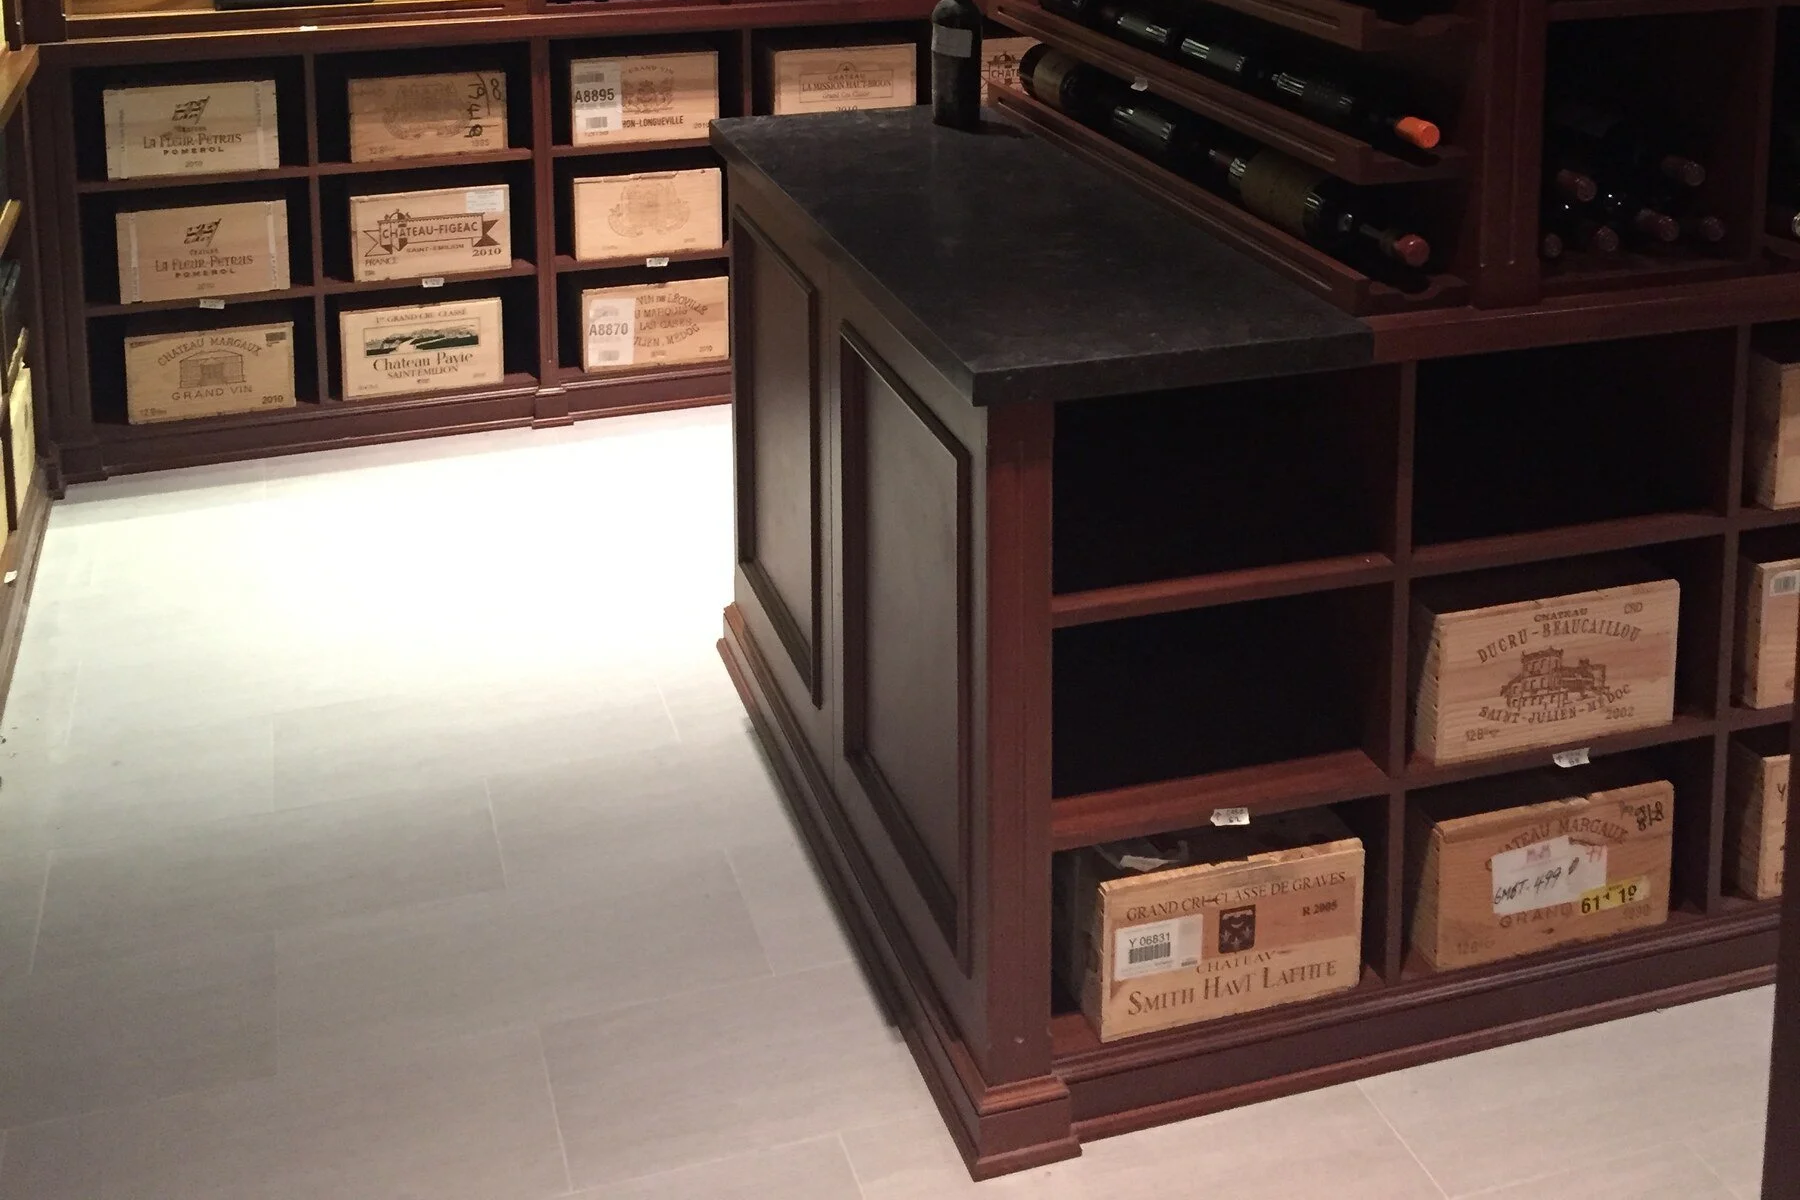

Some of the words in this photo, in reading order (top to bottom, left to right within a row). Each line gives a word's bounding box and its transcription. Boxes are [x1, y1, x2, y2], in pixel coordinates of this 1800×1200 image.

[575, 88, 615, 103] A8895
[163, 146, 225, 156] POMEROL
[472, 247, 502, 257] 2010
[365, 256, 397, 267] FRANCE
[175, 267, 236, 279] POMEROL
[589, 322, 629, 337] A8870
[157, 338, 205, 367] CHATEAU
[209, 337, 262, 357] MARGAUX
[437, 351, 474, 366] Pavie
[172, 388, 224, 402] GRAND
[230, 385, 253, 395] VIN
[1126, 899, 1178, 922] GRAND
[1270, 881, 1290, 896] DE
[1293, 871, 1346, 892] GRAVES
[1302, 905, 1311, 917] R
[1128, 939, 1137, 948] Y
[1139, 932, 1170, 947] 06831
